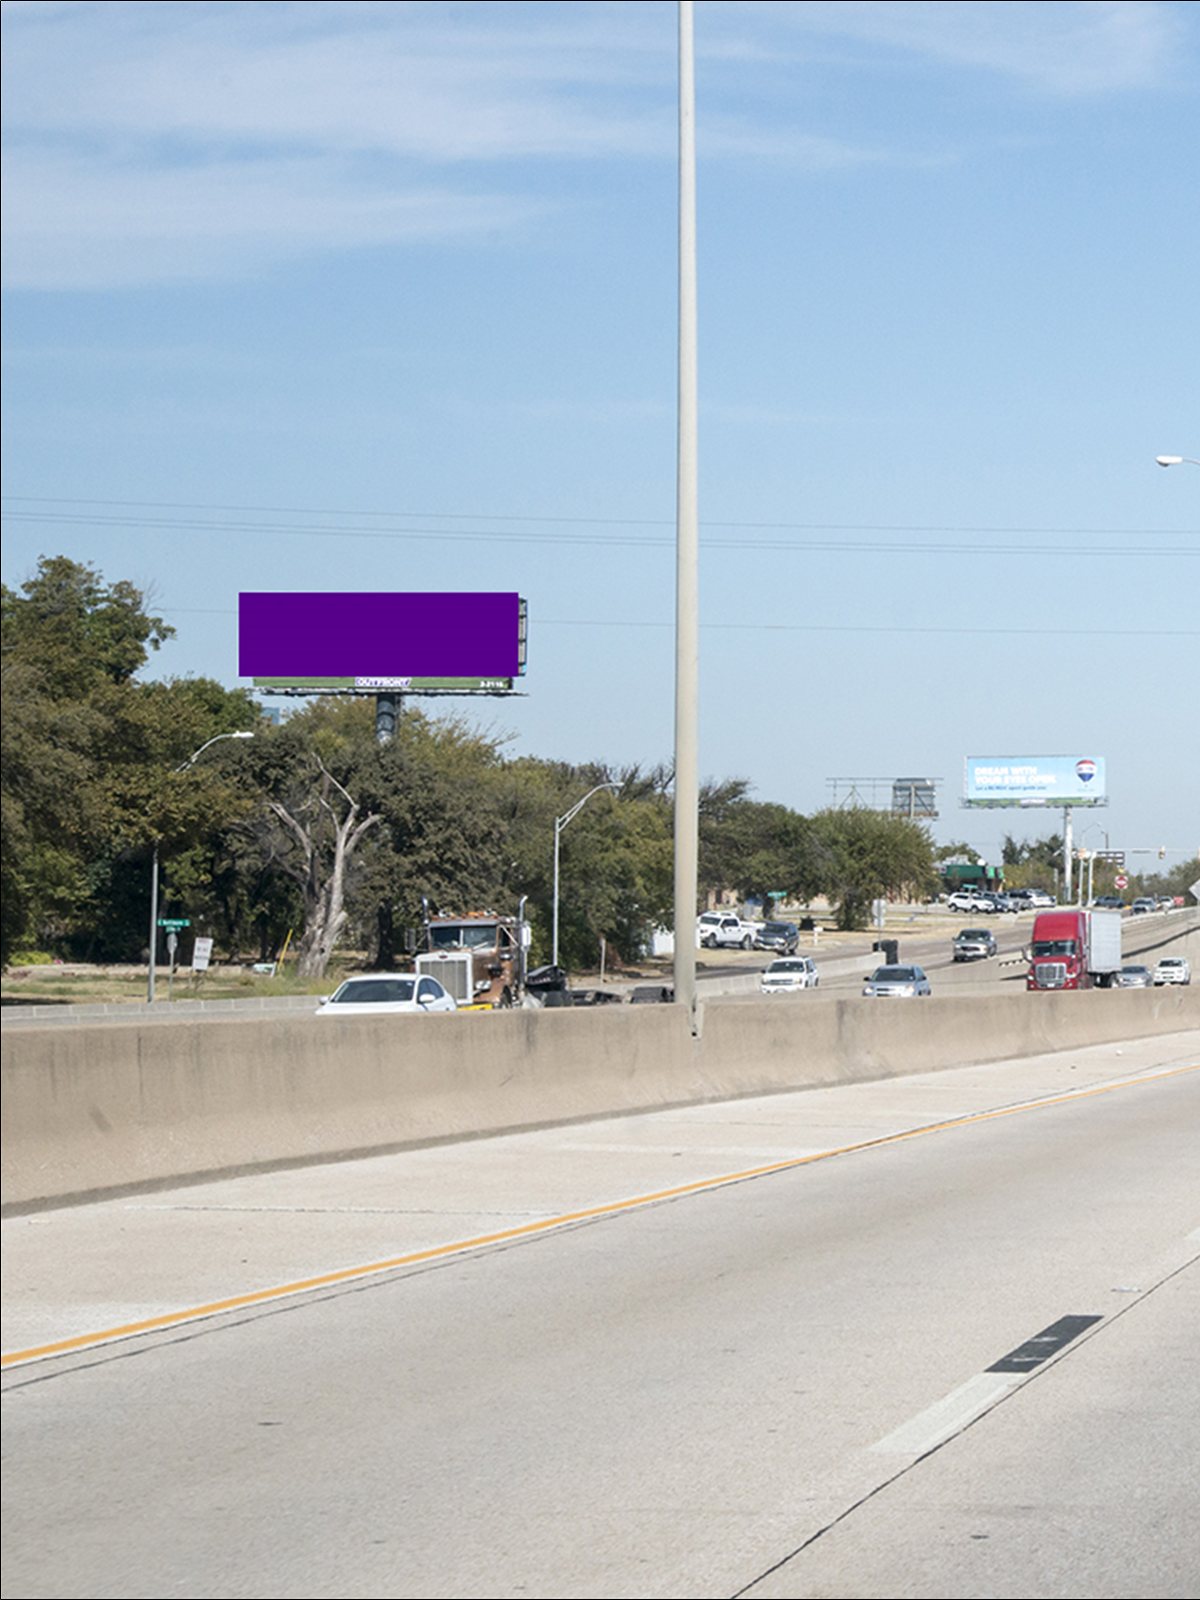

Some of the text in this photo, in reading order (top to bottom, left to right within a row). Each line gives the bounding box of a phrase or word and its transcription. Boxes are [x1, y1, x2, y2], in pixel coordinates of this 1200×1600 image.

[975, 767, 1037, 775] DREAM WITH
[975, 775, 1002, 784] YOUR
[1004, 775, 1027, 784] EYES
